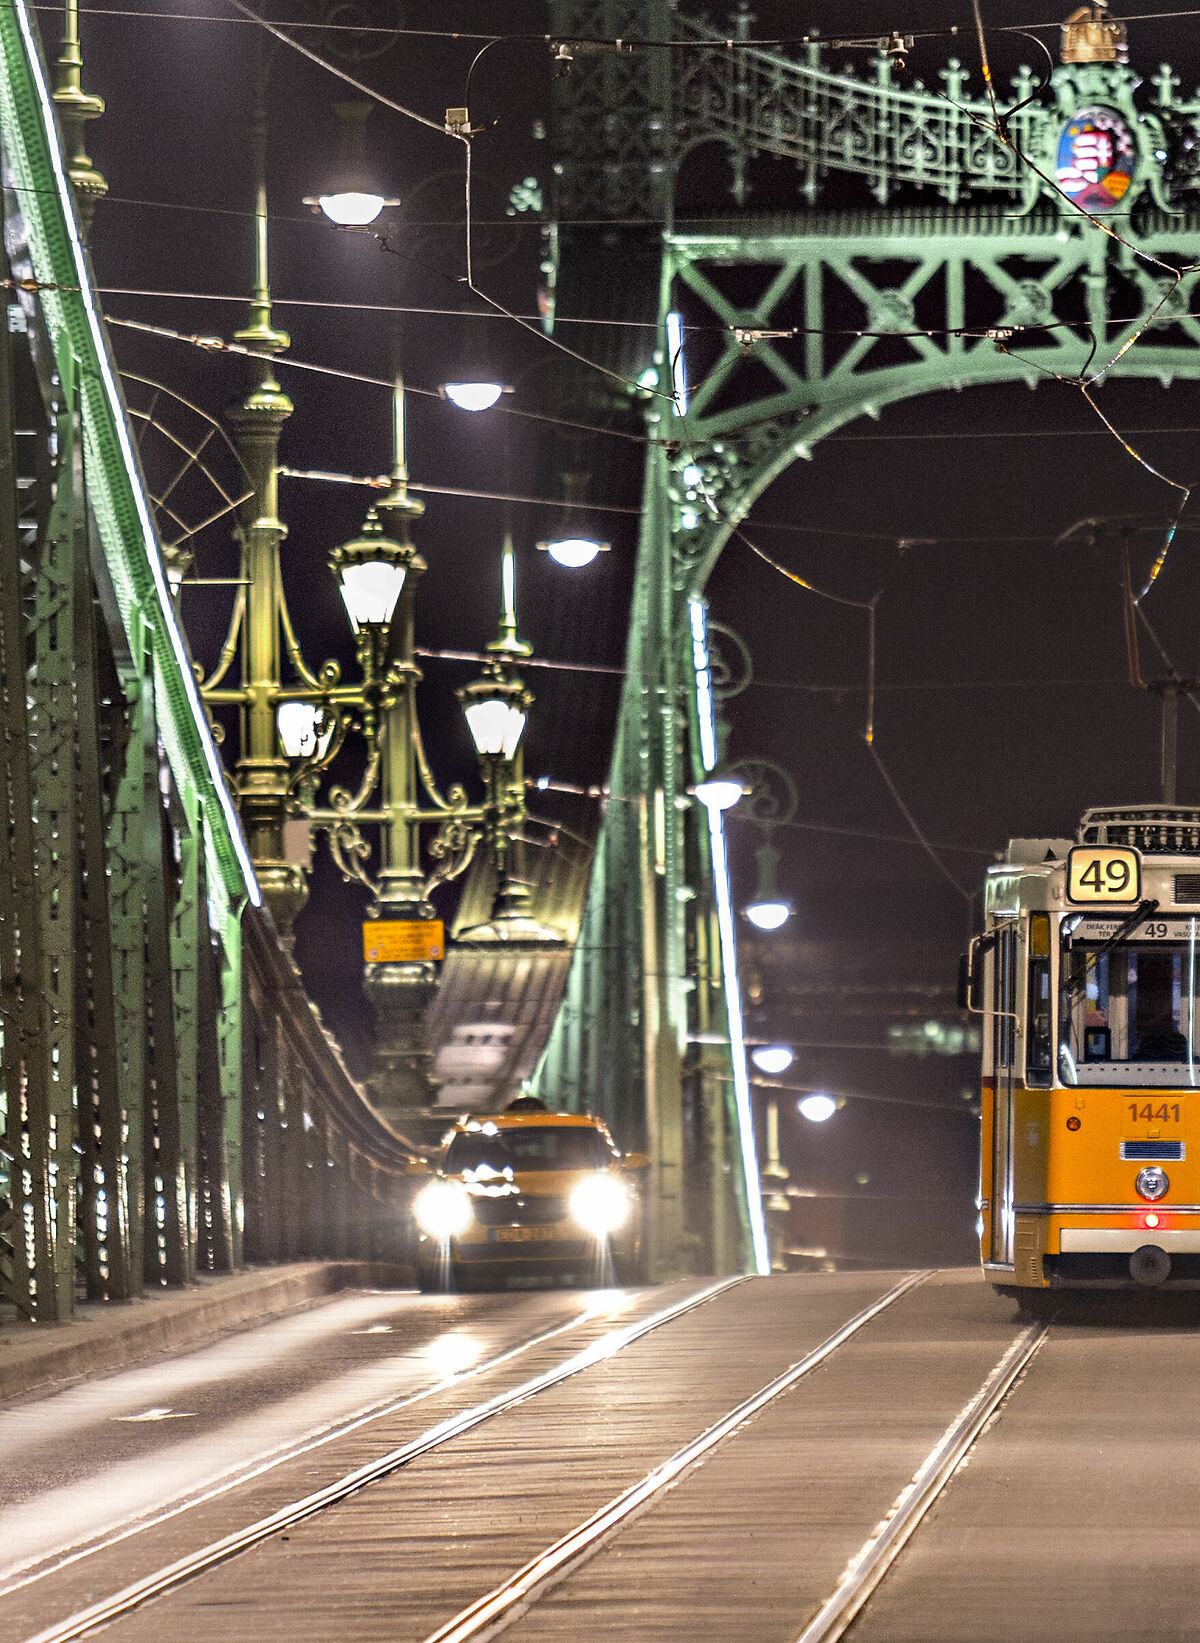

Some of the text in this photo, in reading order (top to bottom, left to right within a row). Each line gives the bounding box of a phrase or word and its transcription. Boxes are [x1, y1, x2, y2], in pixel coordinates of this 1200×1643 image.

[1079, 859, 1131, 893] 49
[1144, 923, 1168, 938] 49
[1128, 1103, 1180, 1122] 1441
